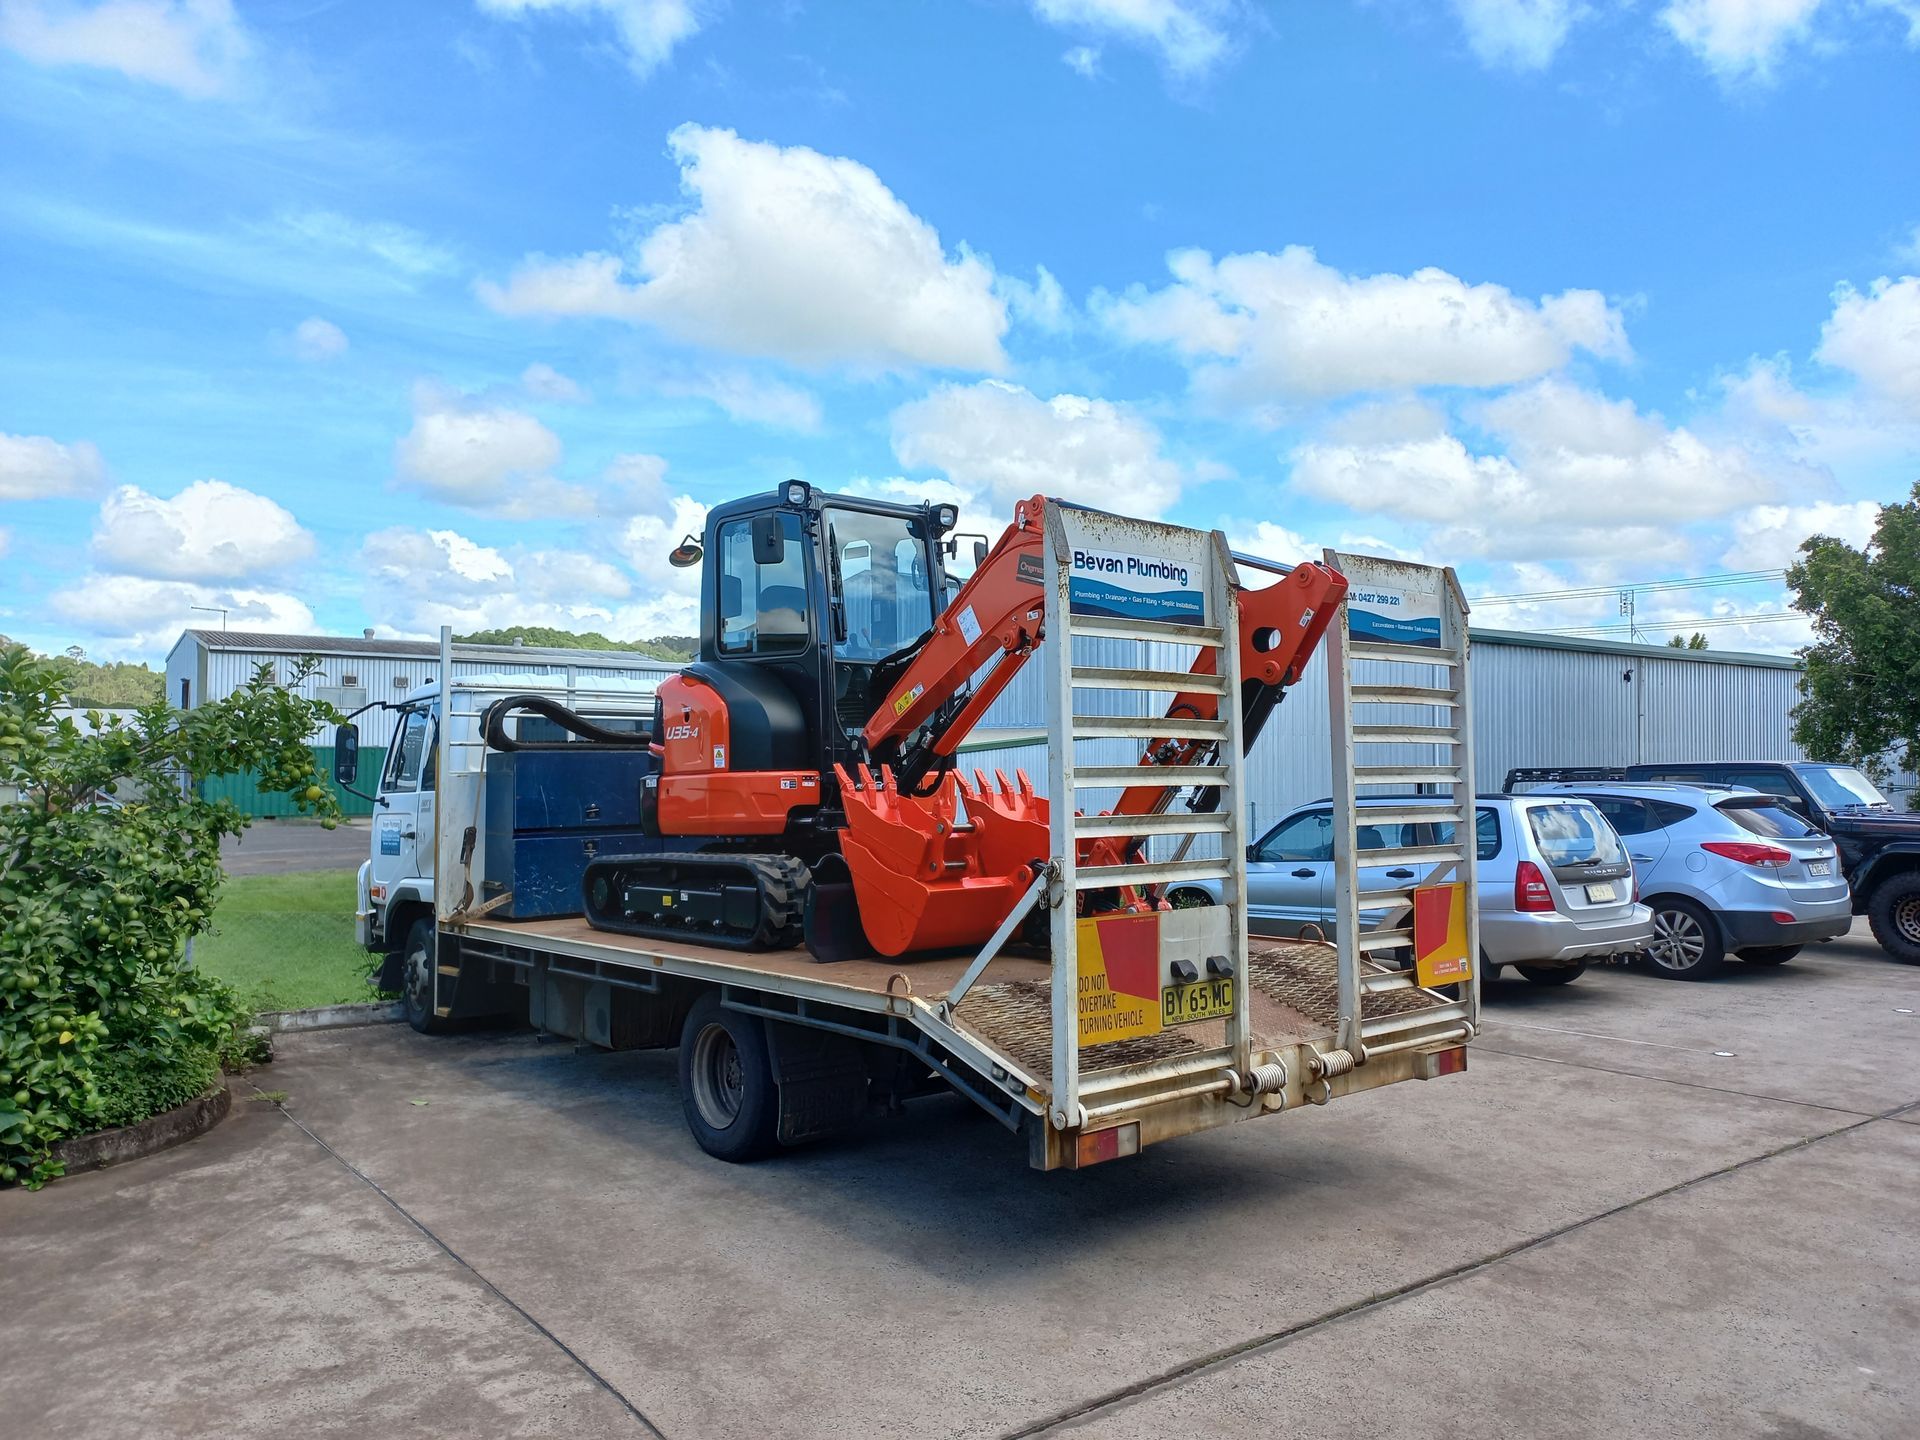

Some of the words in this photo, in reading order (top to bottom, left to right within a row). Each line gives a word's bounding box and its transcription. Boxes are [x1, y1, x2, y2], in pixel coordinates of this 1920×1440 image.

[1074, 551, 1124, 573] Bevan
[1127, 557, 1188, 587] Plumbing
[1074, 590, 1101, 600] Plumbing
[1105, 593, 1128, 603] Drainage
[1358, 593, 1375, 602] 0427
[1376, 595, 1389, 604] 299
[666, 725, 699, 740] U35-4
[1079, 975, 1090, 993] DO
[1091, 973, 1106, 991] NOT
[1079, 993, 1117, 1014] OVERTAKE
[1079, 1015, 1113, 1035] TURNING
[1113, 1009, 1144, 1030] VEHICLE
[1171, 1014, 1185, 1023] NEW
[1187, 1011, 1206, 1020] SOUTH
[1208, 1008, 1226, 1017] WALES
